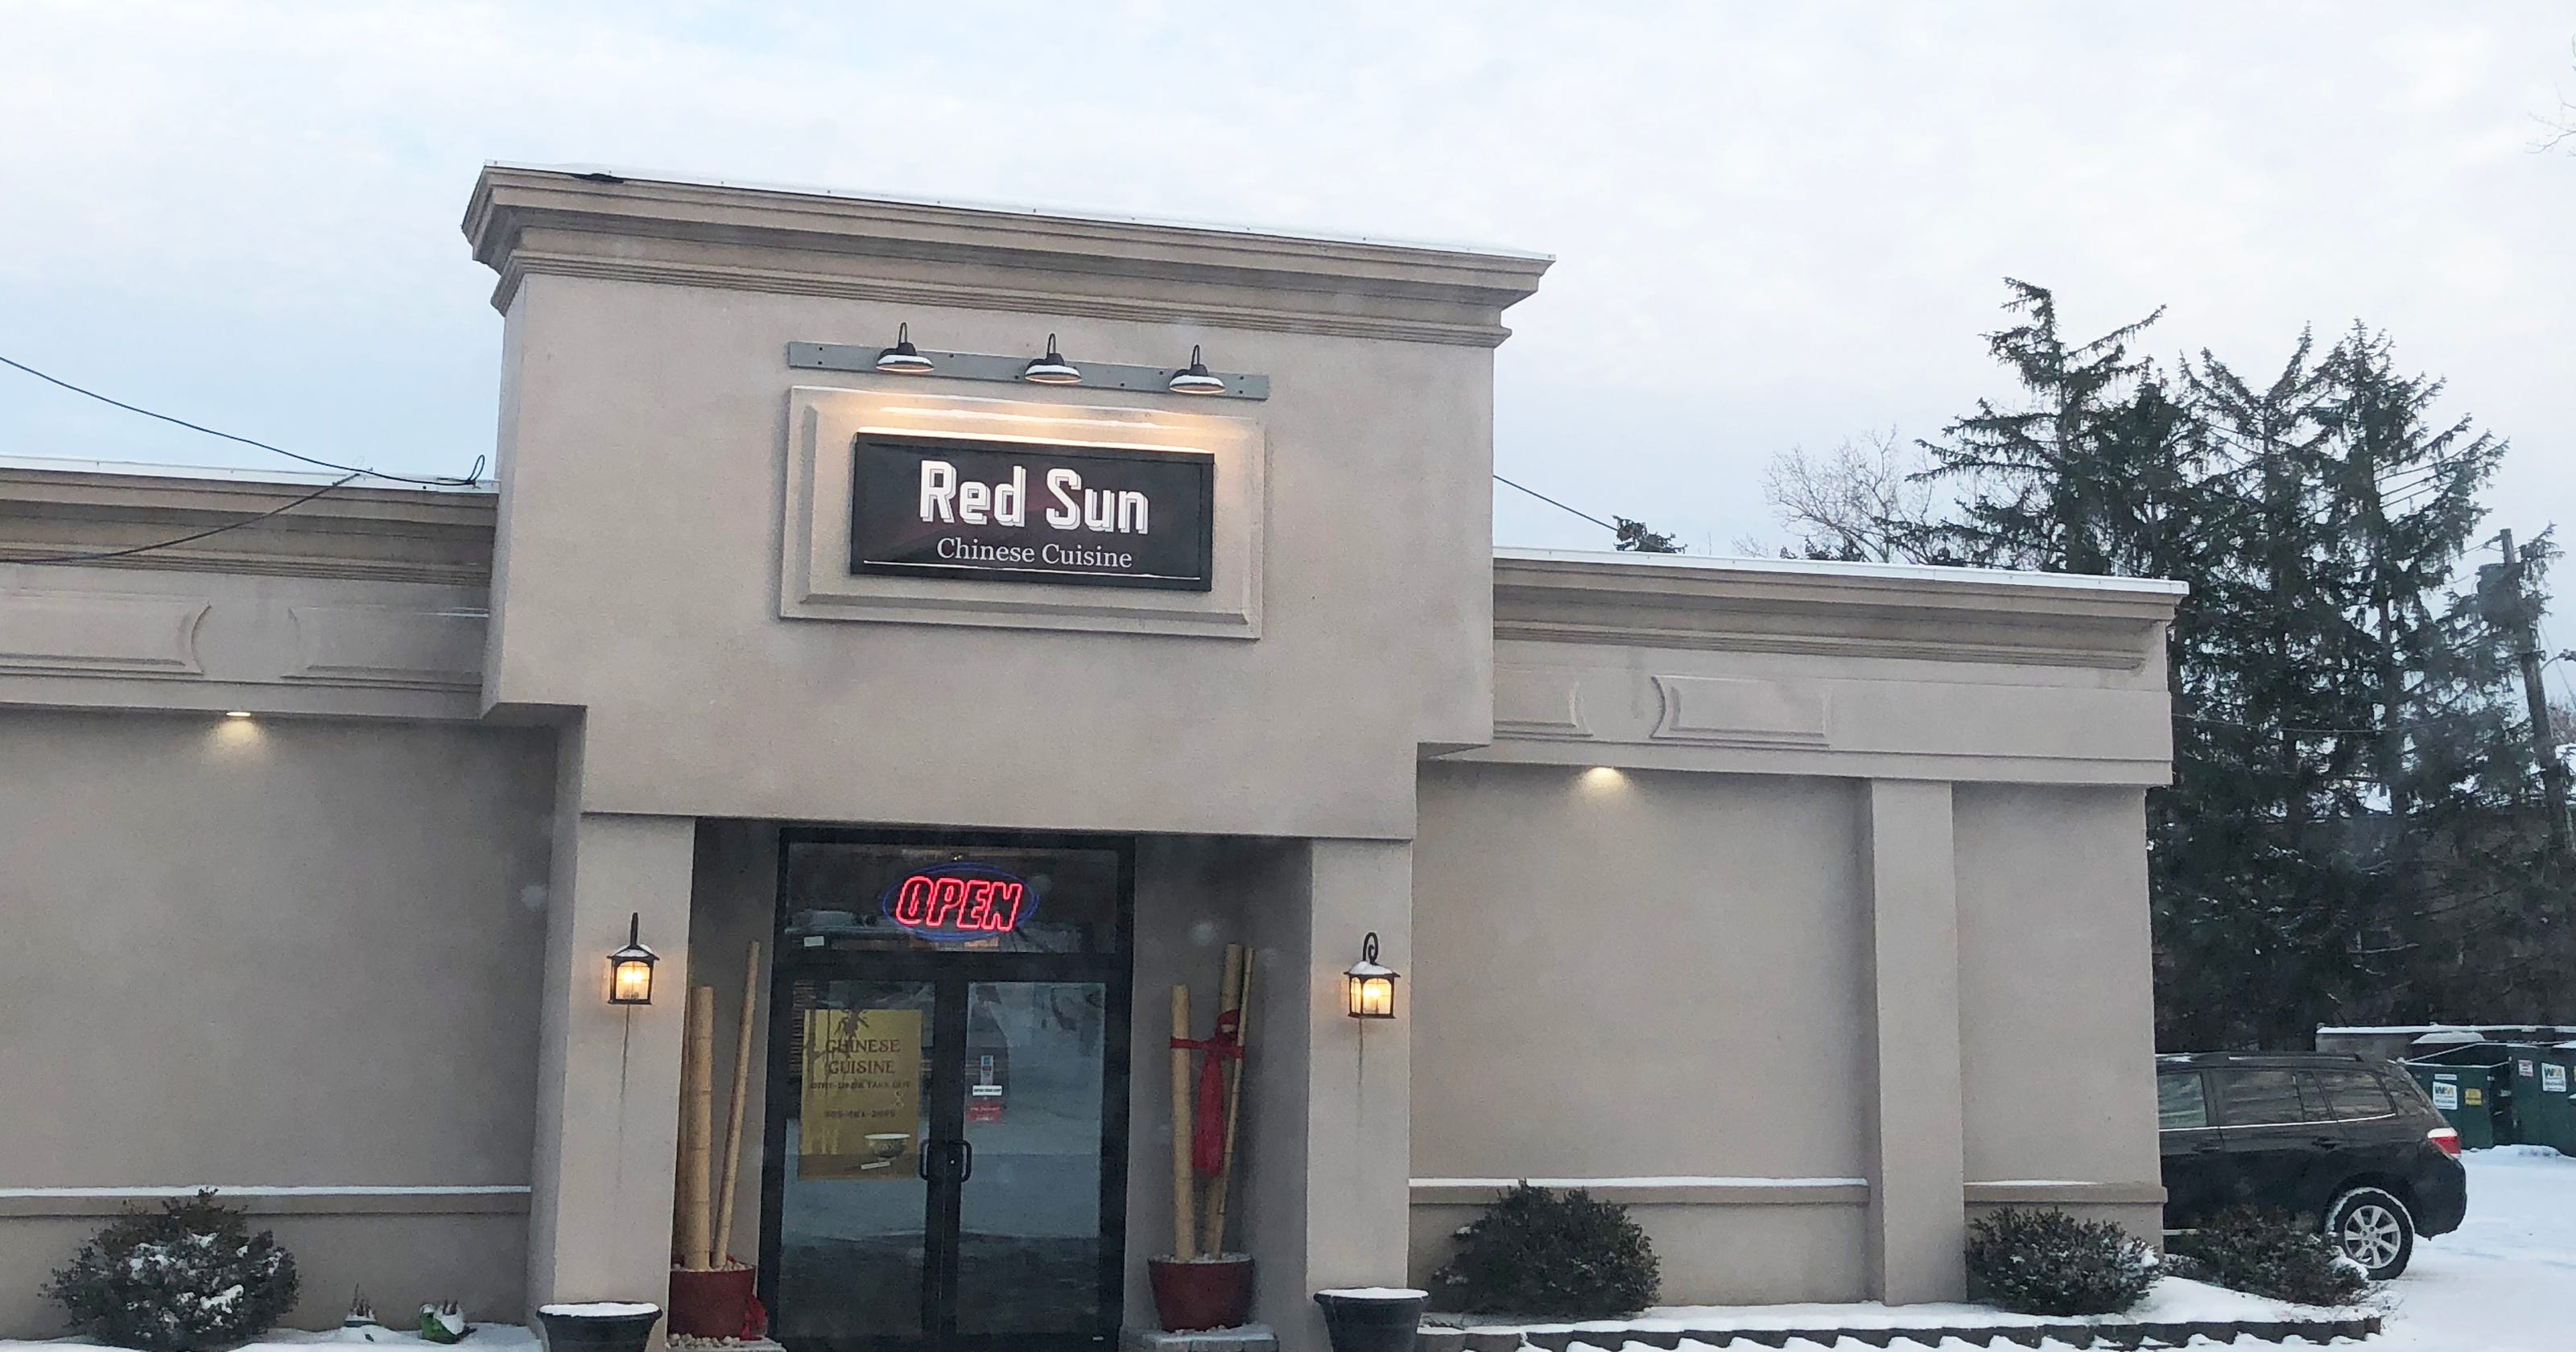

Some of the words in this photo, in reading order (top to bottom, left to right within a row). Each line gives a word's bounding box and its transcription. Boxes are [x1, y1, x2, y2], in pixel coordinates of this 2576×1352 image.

[919, 460, 1026, 527] Red
[1046, 468, 1150, 534] Sun
[937, 537, 1035, 563] Chinese
[1042, 543, 1133, 567] Cuisine
[895, 875, 1023, 933] OPEN
[826, 1039, 901, 1053] CHINESE
[828, 1060, 895, 1074] CUISINE
